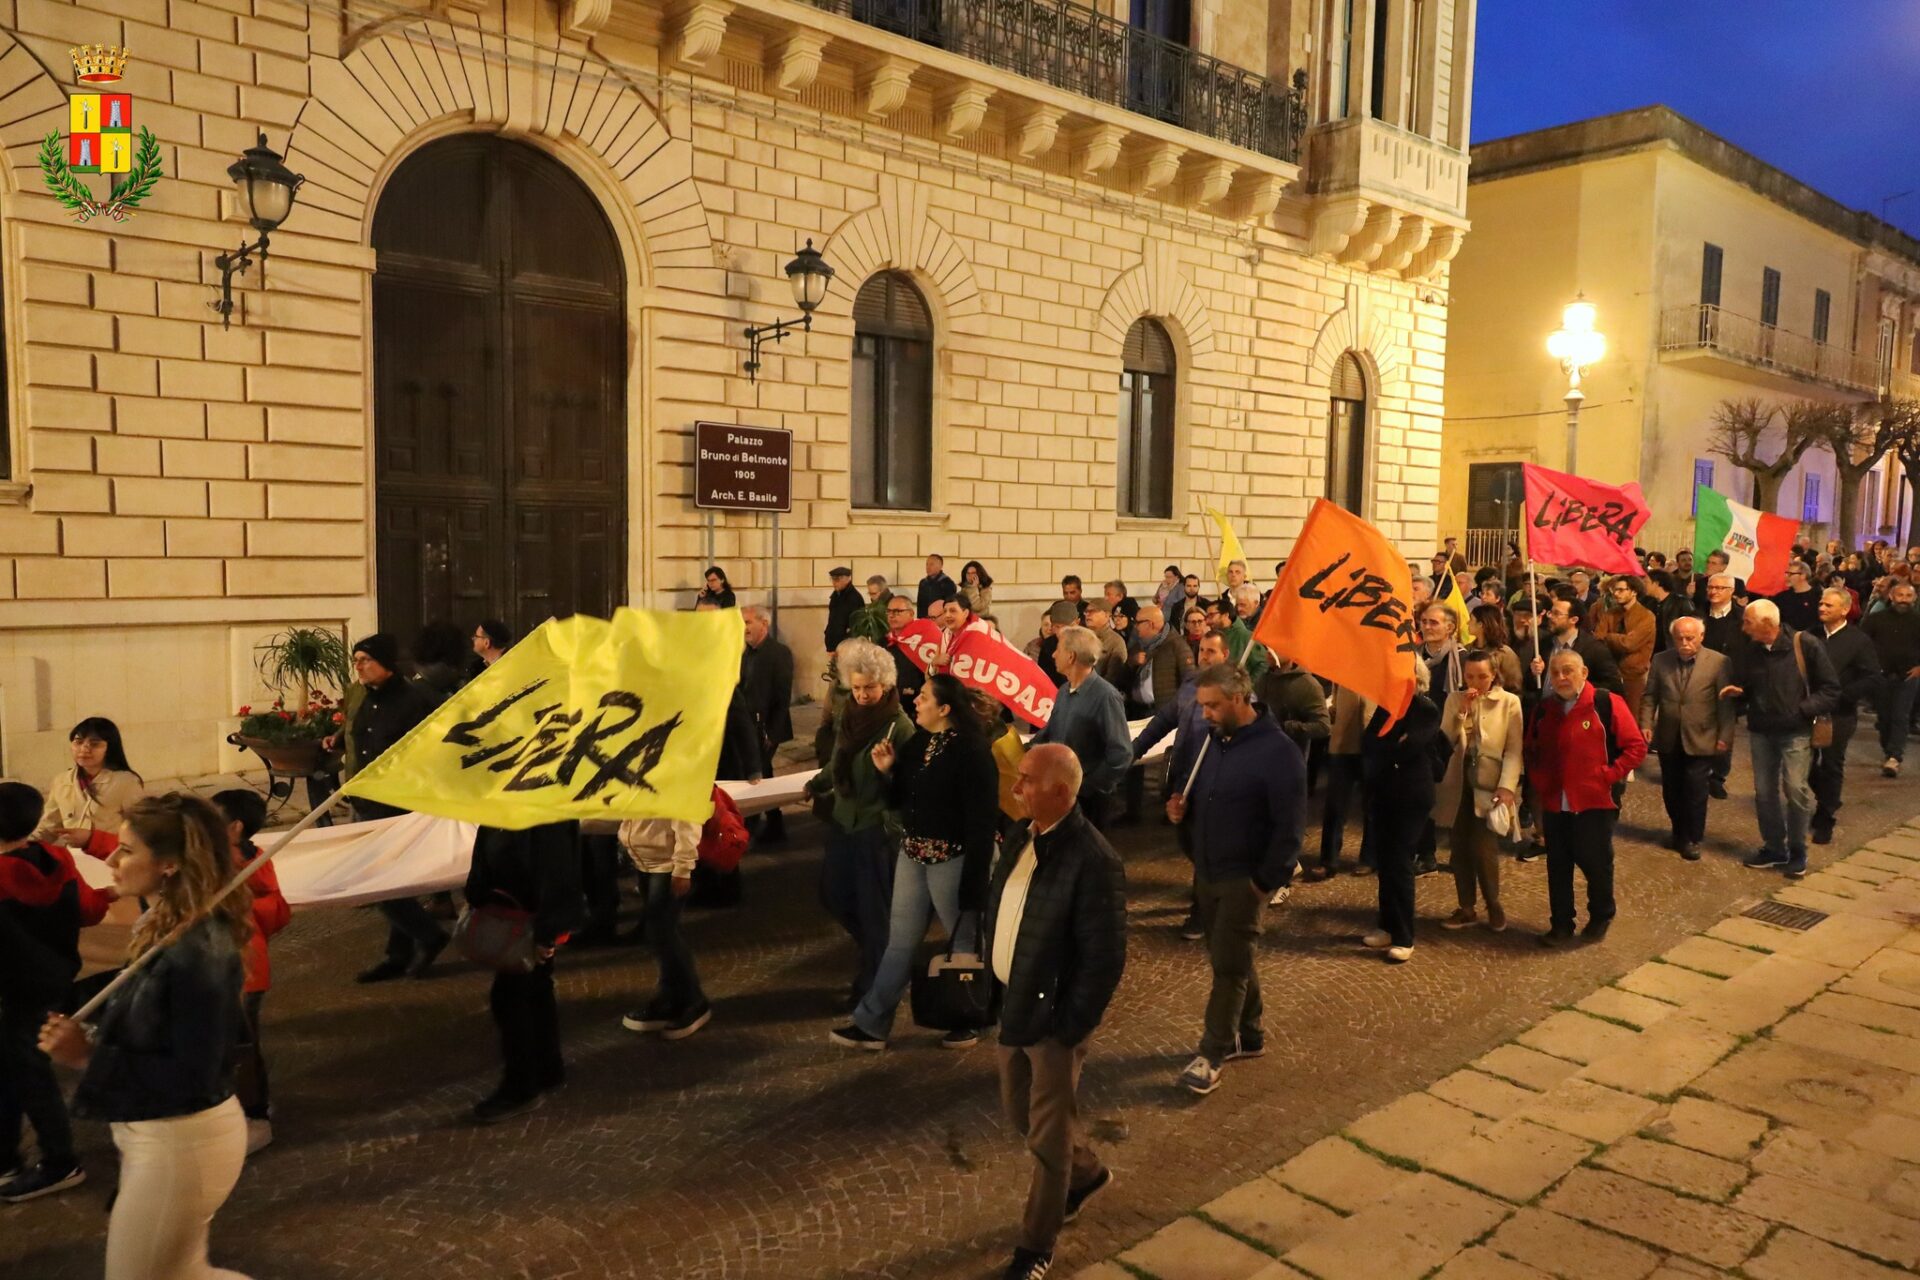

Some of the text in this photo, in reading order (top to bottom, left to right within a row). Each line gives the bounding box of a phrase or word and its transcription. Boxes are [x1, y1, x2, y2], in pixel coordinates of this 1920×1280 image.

[727, 433, 763, 446] Palazzo
[700, 449, 788, 466] Bruno di Belmonte
[734, 470, 756, 480] 1905
[710, 489, 778, 503] Arch. E. Basile
